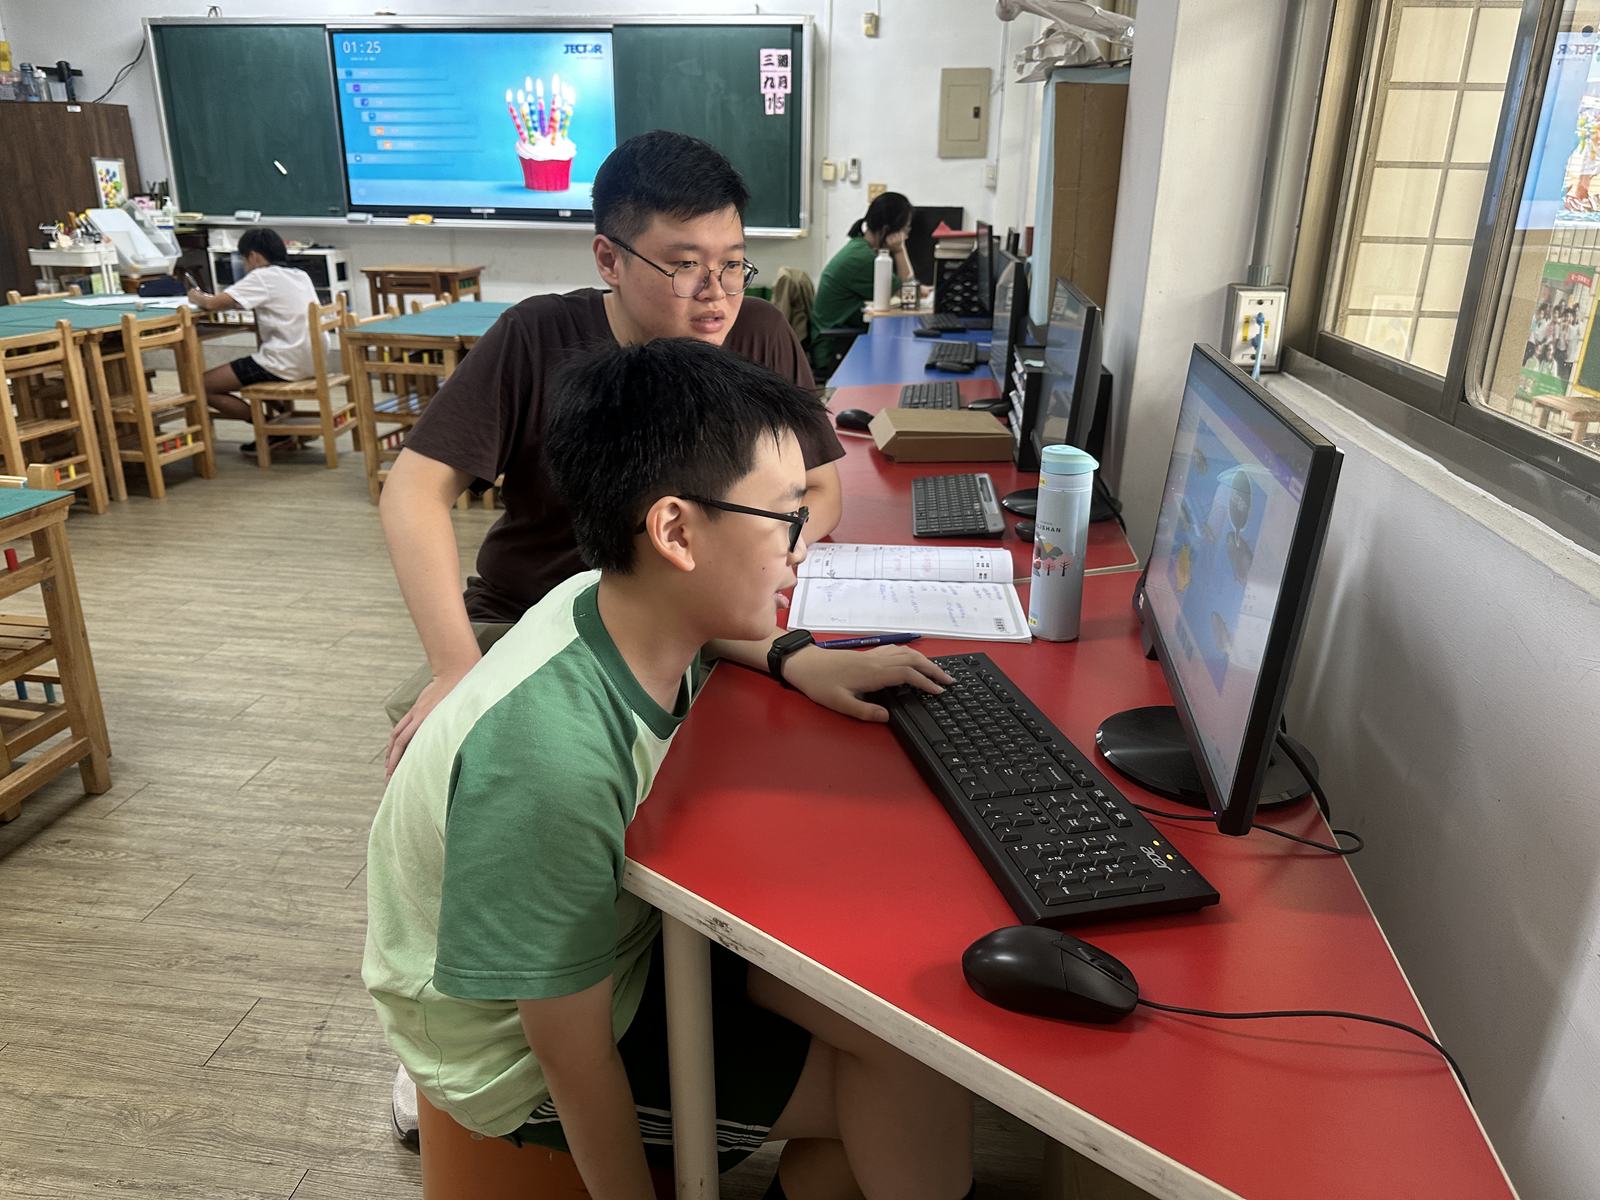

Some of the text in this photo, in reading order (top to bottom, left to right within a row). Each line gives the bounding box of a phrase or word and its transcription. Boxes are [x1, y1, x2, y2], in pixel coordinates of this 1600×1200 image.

[342, 40, 382, 54] 01:25
[763, 75, 788, 89] 九月
[1140, 846, 1173, 871] acer
